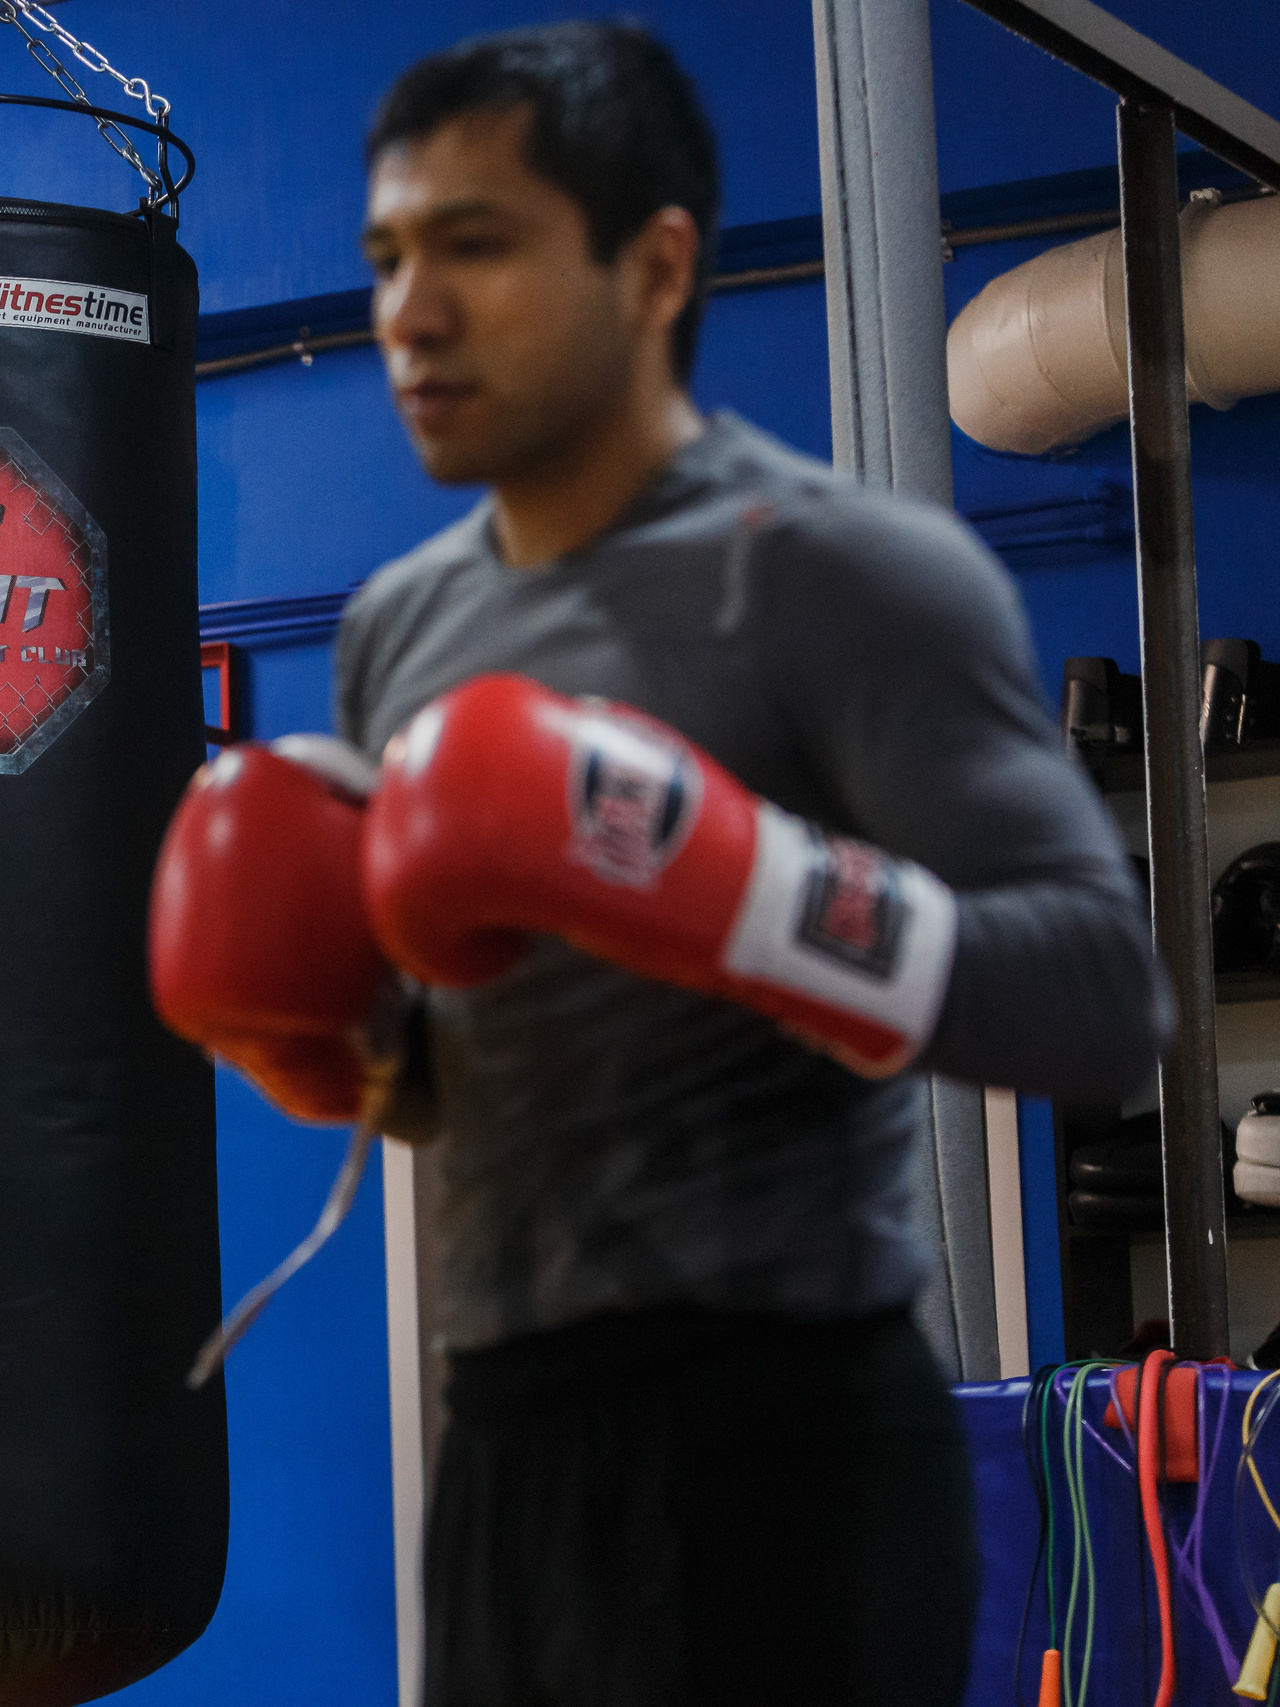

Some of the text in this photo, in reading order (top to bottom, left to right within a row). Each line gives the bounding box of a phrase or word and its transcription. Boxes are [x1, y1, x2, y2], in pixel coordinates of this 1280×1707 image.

[13, 314, 71, 326] equipment
[76, 320, 143, 336] manufacturer
[20, 646, 87, 667] CLUB
